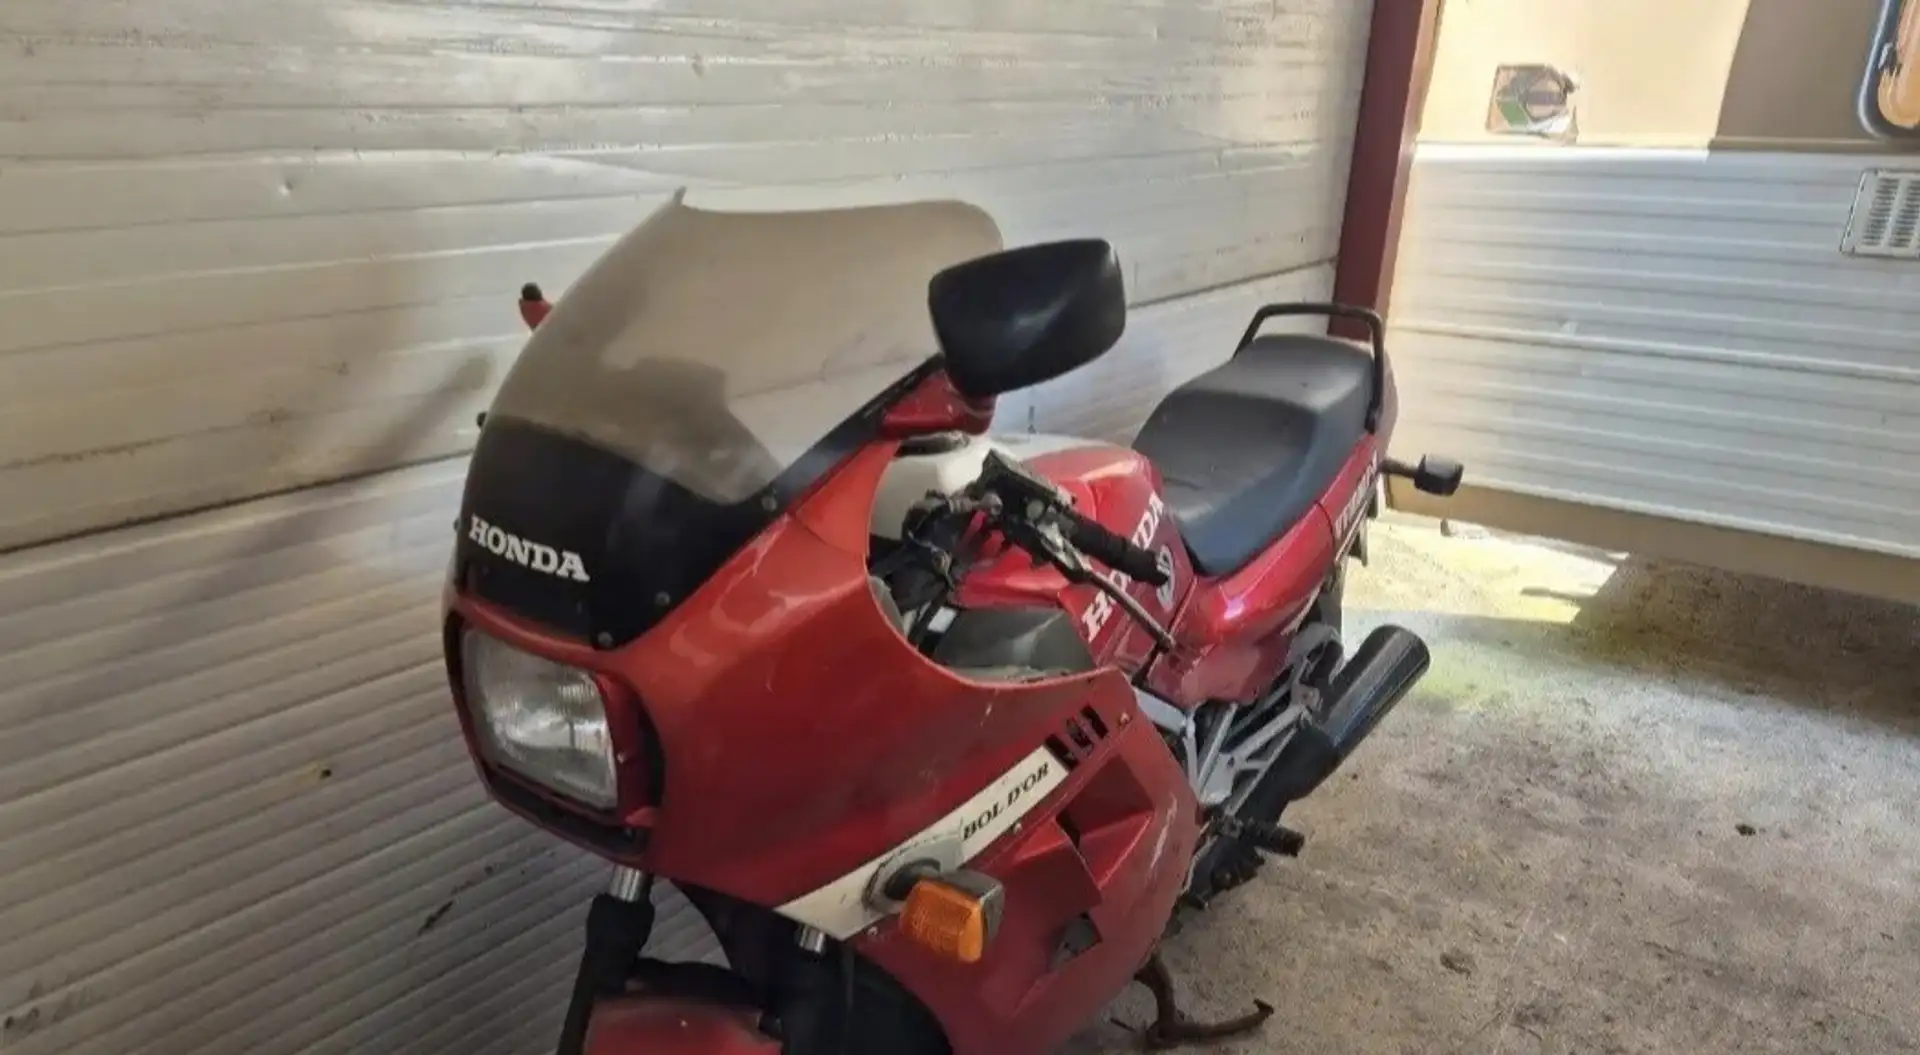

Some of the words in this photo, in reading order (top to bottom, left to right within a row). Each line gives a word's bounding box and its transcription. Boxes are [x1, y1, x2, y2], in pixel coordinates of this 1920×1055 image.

[468, 514, 590, 582] HONDA
[1081, 490, 1164, 643] HODA
[963, 801, 1005, 841] BOL
